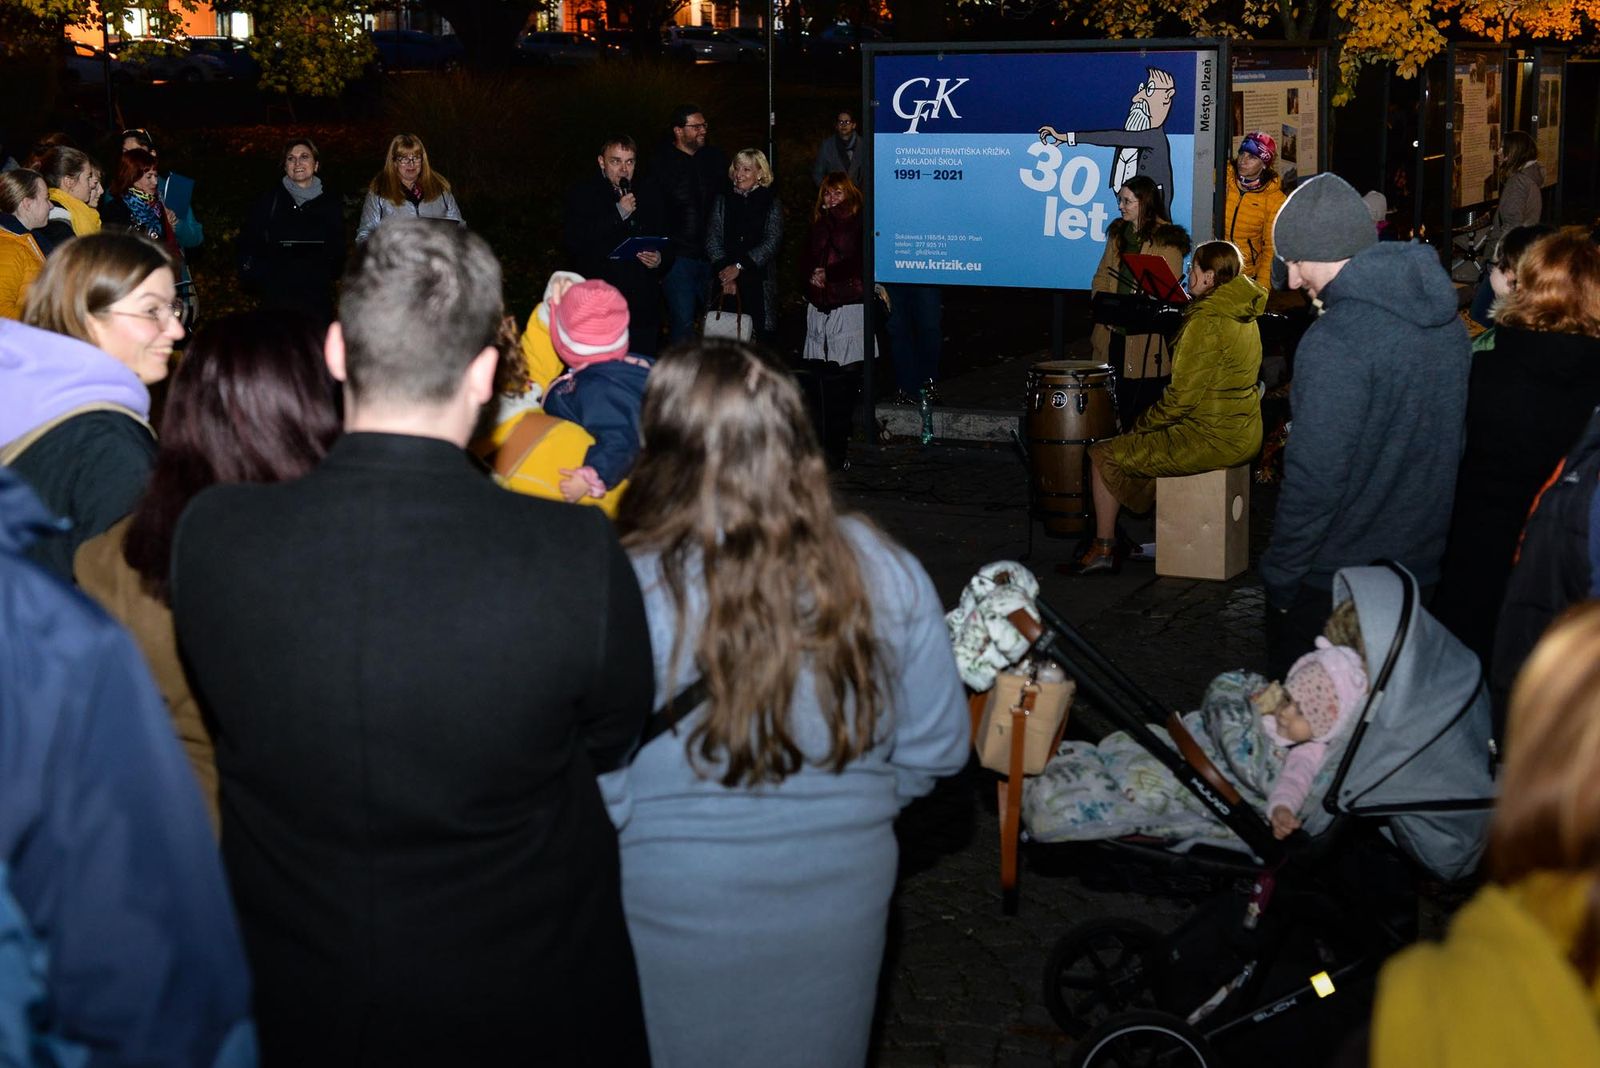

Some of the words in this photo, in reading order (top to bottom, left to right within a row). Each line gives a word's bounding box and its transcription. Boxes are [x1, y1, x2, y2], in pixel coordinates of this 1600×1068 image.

[1201, 59, 1211, 90] Plzeň
[938, 157, 963, 166] ŠKOLA
[1019, 140, 1100, 206] 30
[1043, 196, 1108, 242] let
[895, 259, 982, 271] www.krizik.eu
